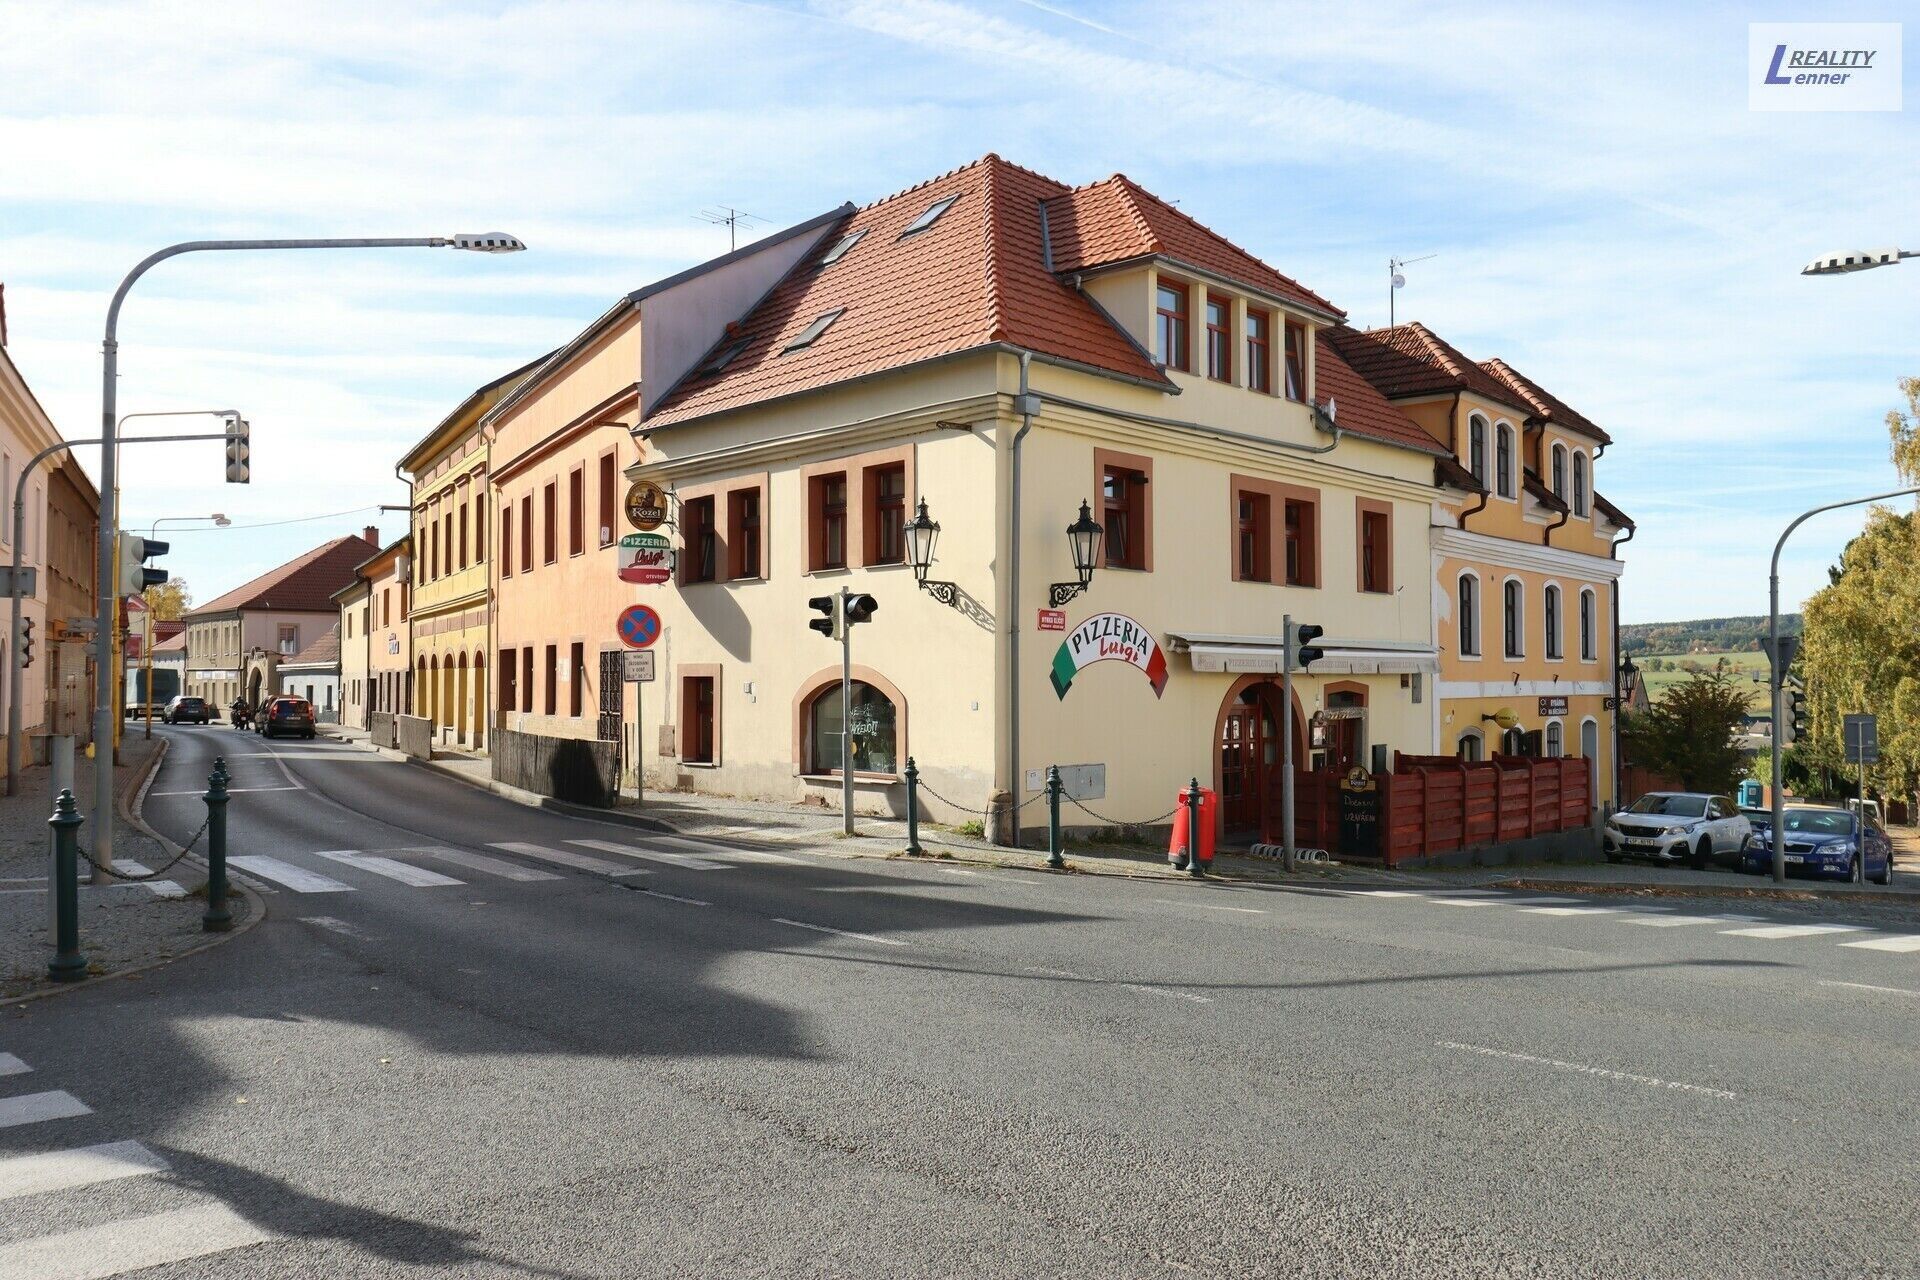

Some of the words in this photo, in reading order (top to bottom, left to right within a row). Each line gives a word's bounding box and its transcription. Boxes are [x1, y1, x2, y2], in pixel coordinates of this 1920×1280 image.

[632, 507, 661, 518] Kozel
[623, 537, 669, 547] PIZZERIA
[628, 548, 665, 567] Luigi
[1072, 617, 1148, 655] PIZZERIA
[1100, 637, 1139, 662] Luigi
